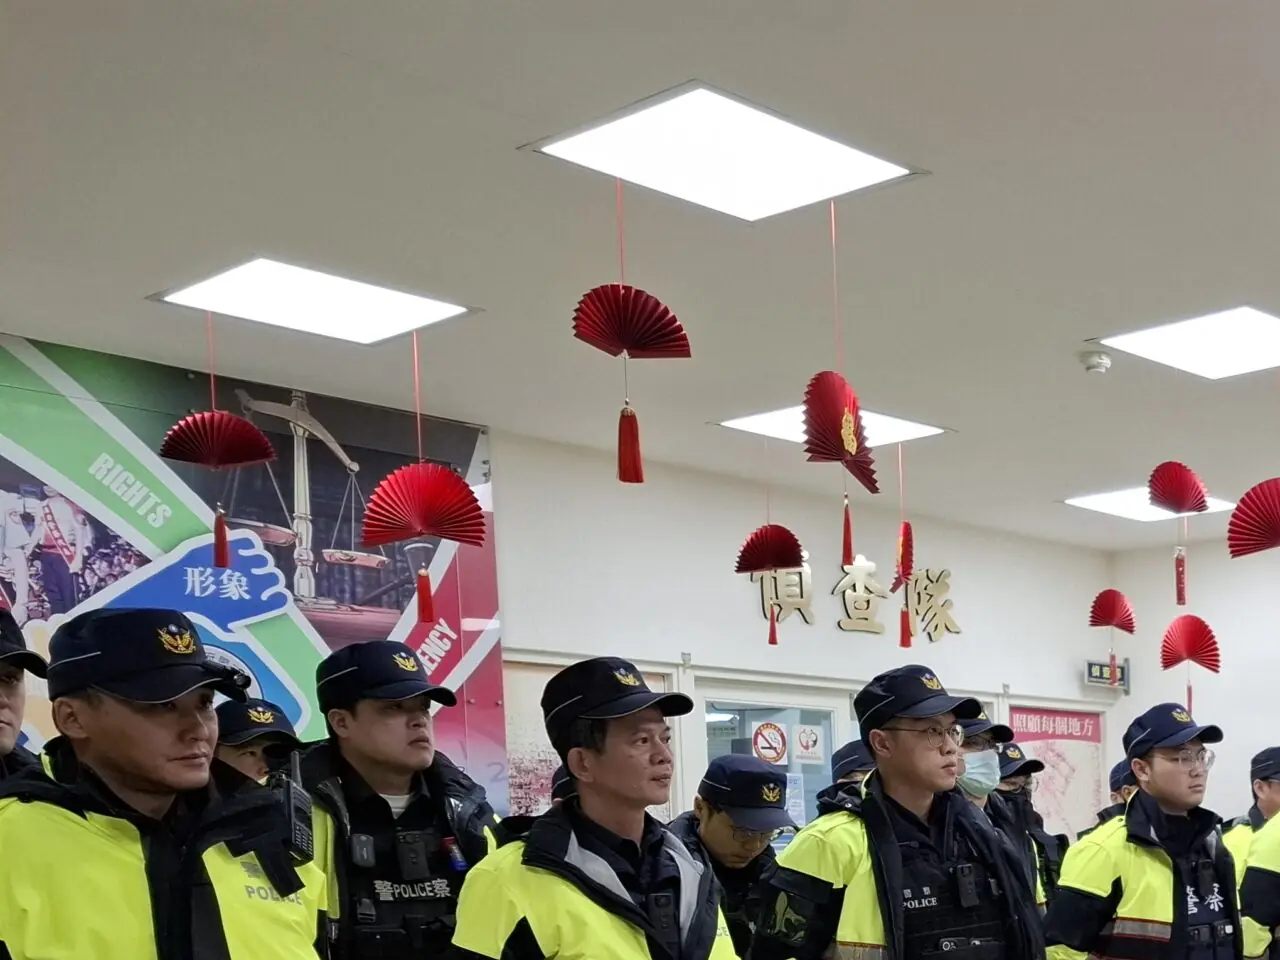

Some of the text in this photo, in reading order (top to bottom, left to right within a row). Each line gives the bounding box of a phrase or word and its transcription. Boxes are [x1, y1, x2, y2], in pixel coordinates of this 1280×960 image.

[88, 452, 173, 528] RIGHTS
[183, 566, 252, 600] 形象
[416, 617, 458, 676] ENCY
